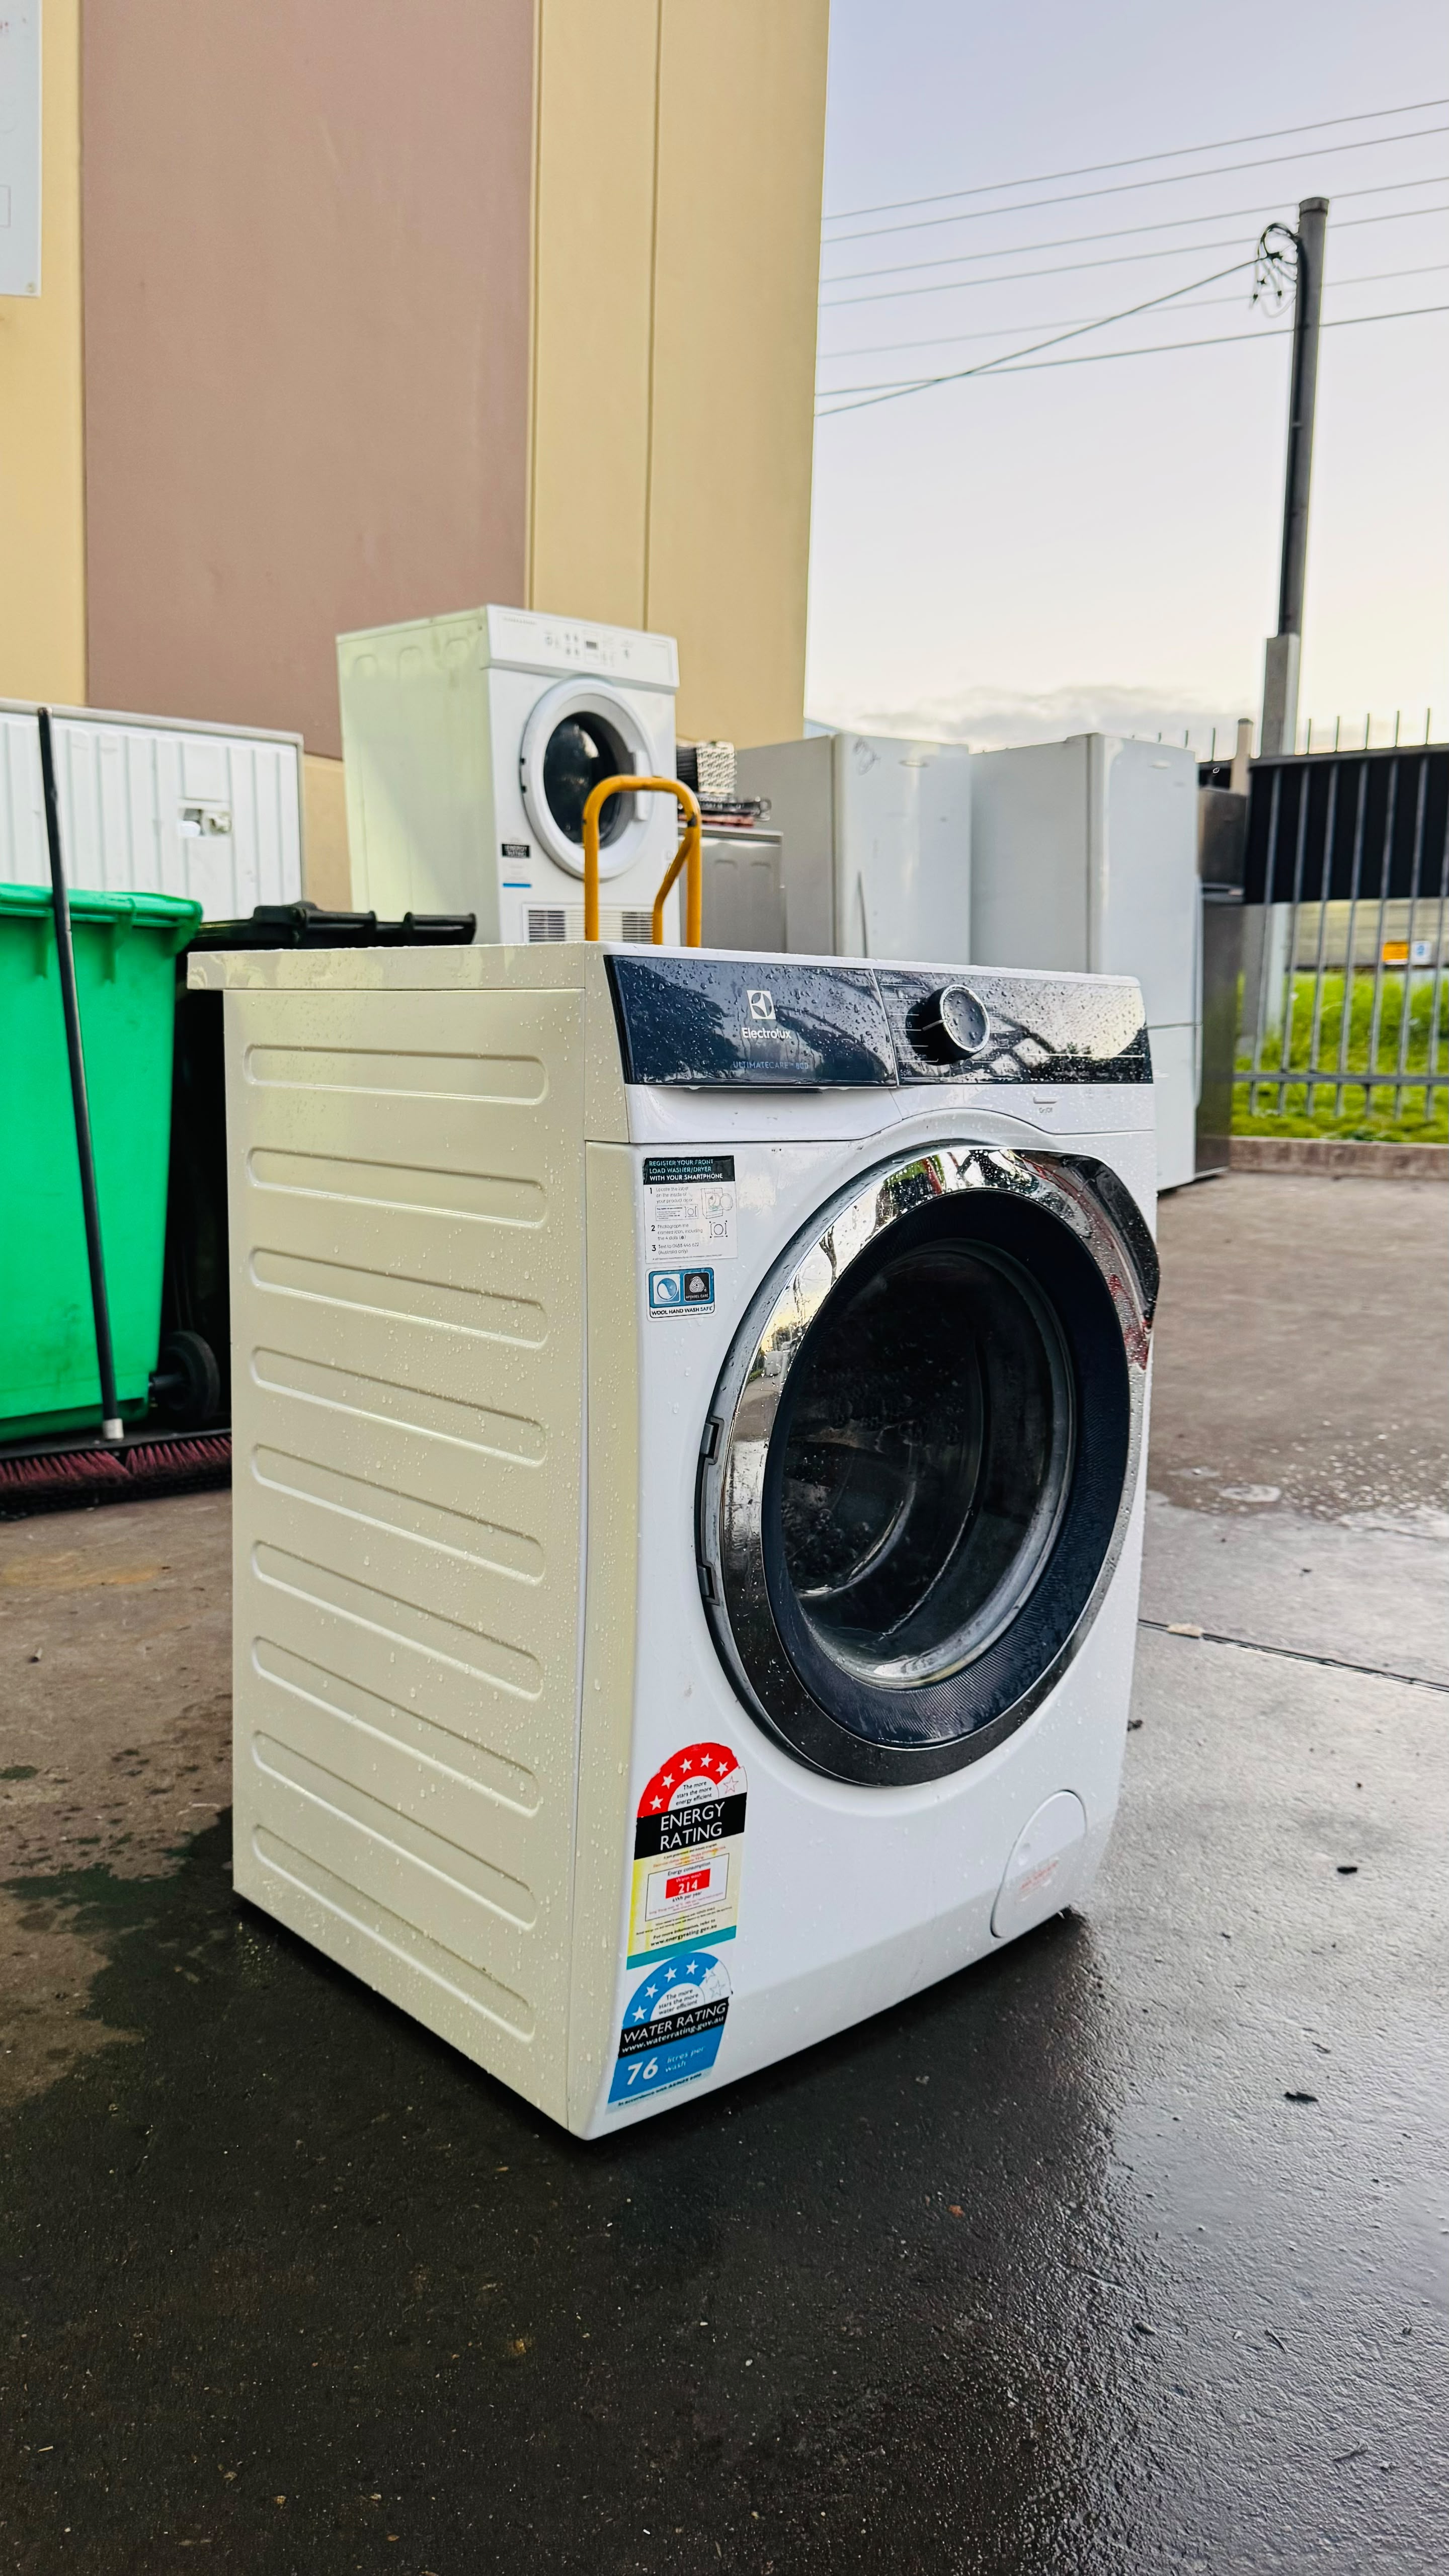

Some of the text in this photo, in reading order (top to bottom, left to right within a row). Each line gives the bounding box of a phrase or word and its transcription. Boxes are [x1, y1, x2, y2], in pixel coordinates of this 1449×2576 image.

[741, 1027, 792, 1039] Electrolux
[693, 1793, 712, 1801] efficient
[661, 1801, 725, 1831] ENERGY
[660, 1821, 722, 1851] RATING
[683, 1862, 710, 1872] consumption
[678, 1879, 698, 1894] 214
[684, 1993, 698, 2001] more
[659, 2007, 675, 2015] water
[624, 2002, 727, 2044] WATER RATING
[622, 2016, 725, 2053] www.waterrating.gov.au
[627, 2046, 705, 2085] 76 litres per
[665, 2060, 686, 2072] wash
